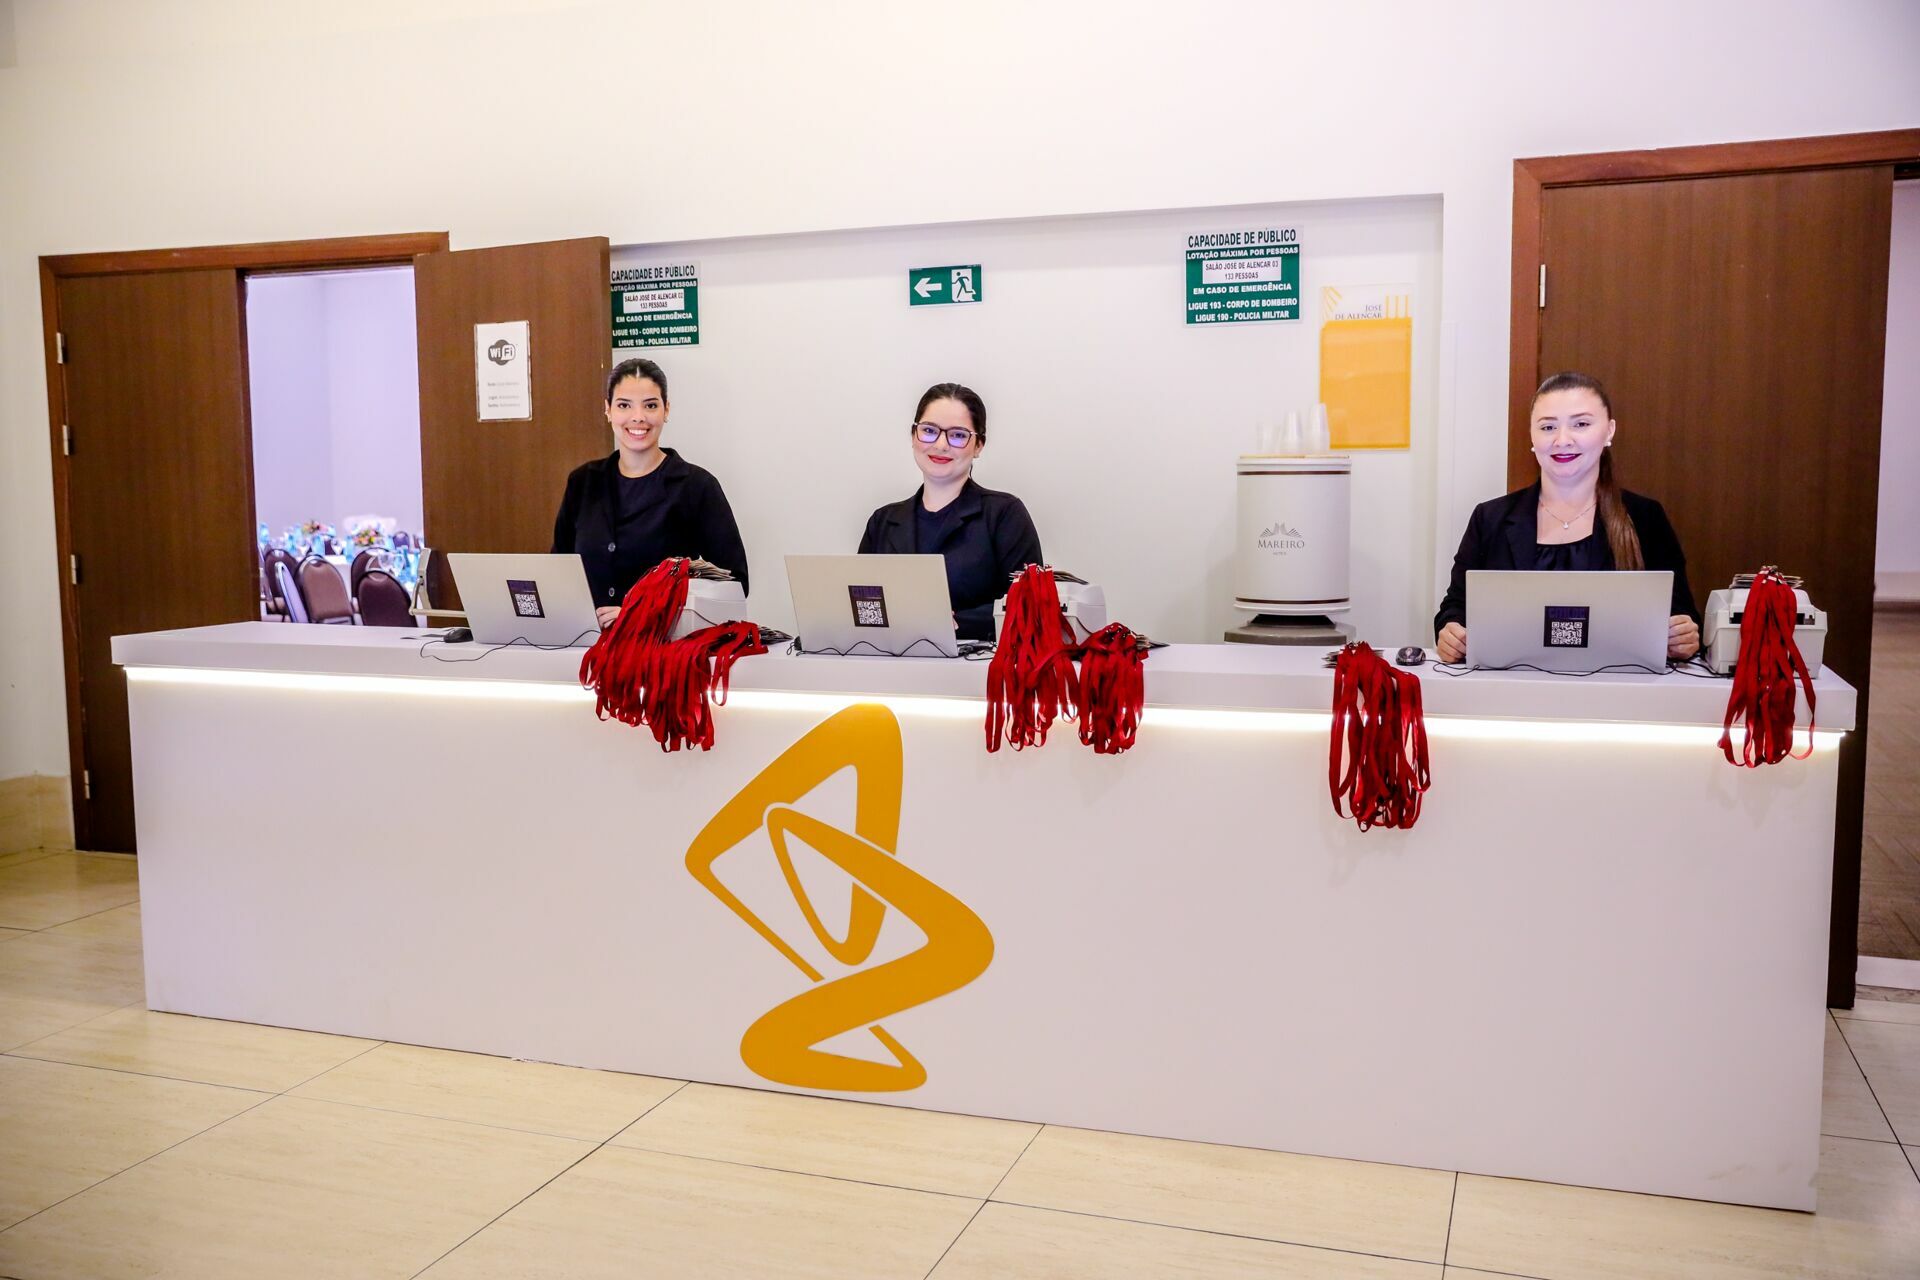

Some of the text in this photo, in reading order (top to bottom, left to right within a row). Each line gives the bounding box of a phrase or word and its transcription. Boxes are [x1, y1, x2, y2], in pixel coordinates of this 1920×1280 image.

[1188, 228, 1296, 247] CAPACIDADE DE PÚBLICO
[1187, 251, 1218, 260] LOTAÇÃO
[1220, 249, 1248, 257] MÁXIMA
[612, 264, 694, 281] CAPACIDADE DE PÚBLICO
[1241, 282, 1291, 292] EMERGÊNCIA
[1227, 300, 1249, 308] CORPO
[1262, 298, 1297, 306] BOMBEIRO
[653, 311, 692, 320] EMERGÊNCIA
[1258, 540, 1304, 548] MAREIRO
